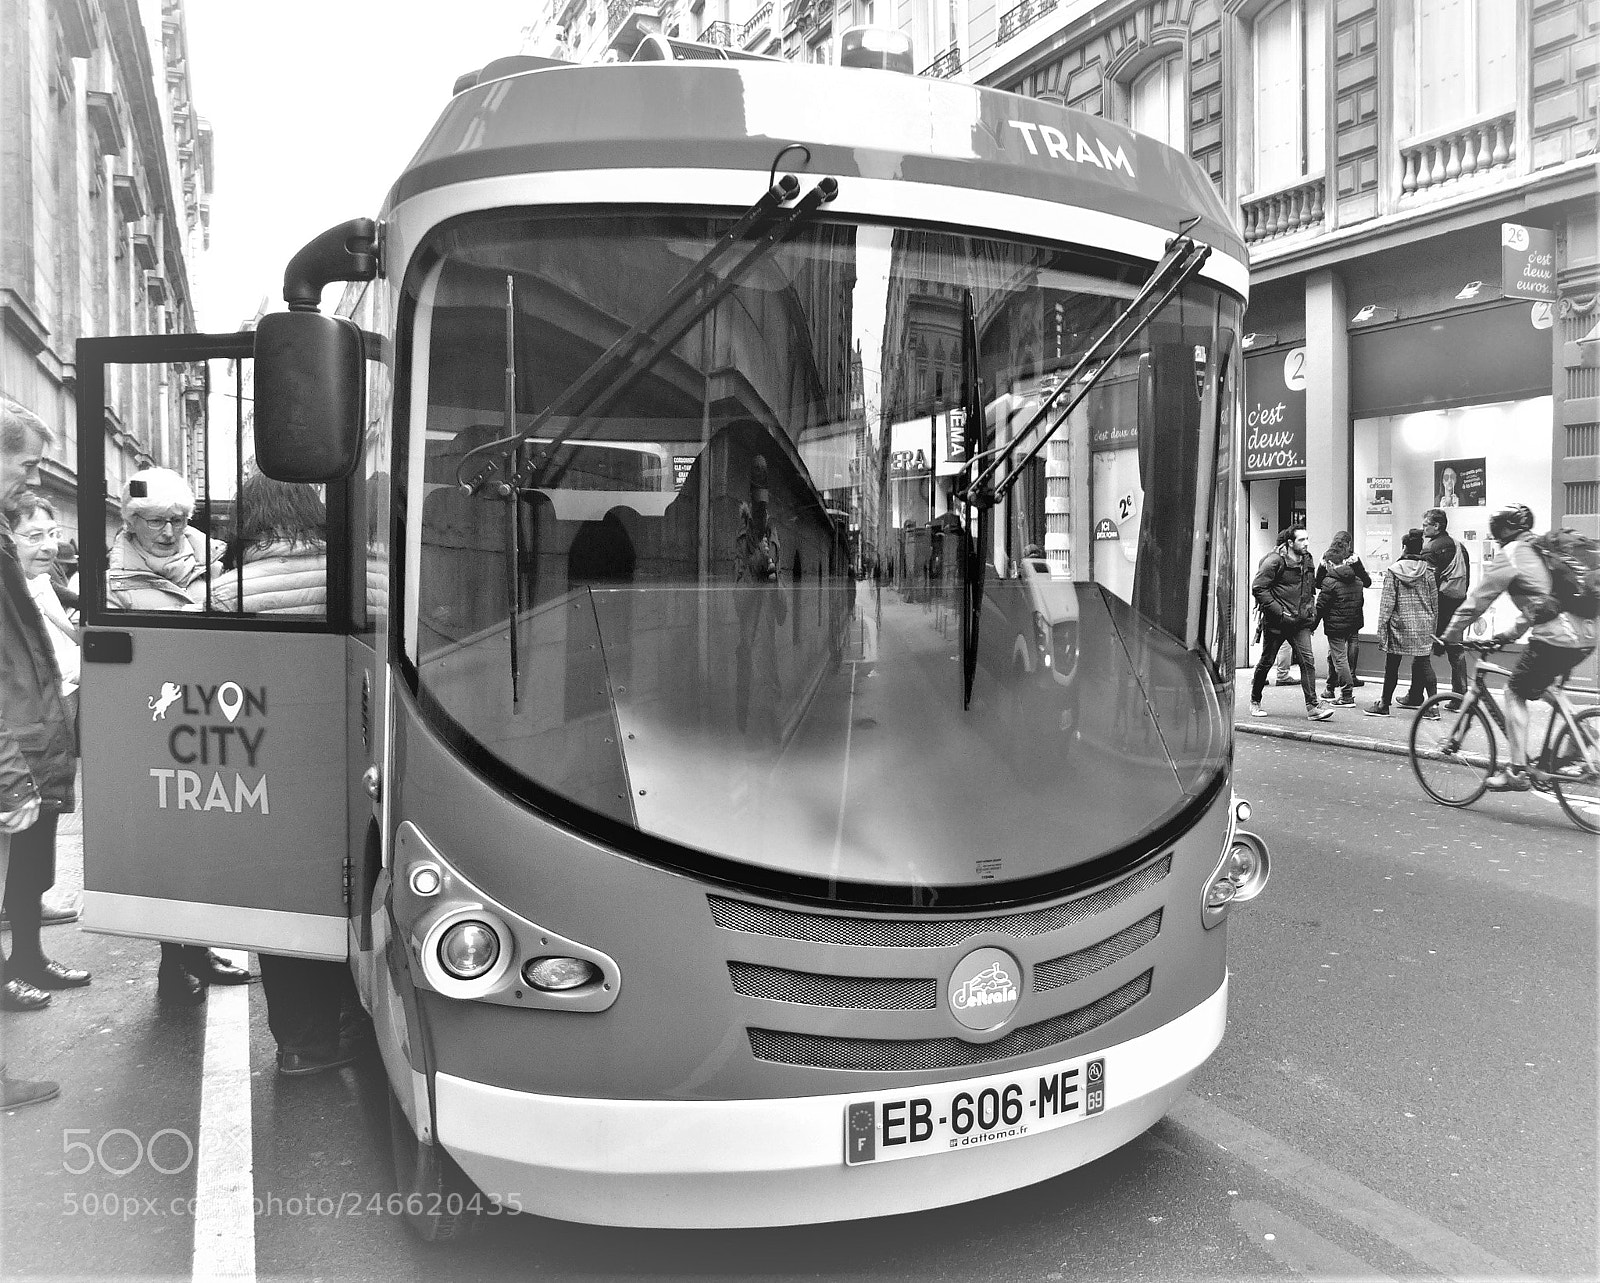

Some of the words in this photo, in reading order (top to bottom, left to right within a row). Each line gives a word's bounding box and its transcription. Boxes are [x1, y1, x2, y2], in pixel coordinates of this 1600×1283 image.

[1008, 120, 1135, 178] TRAM
[1508, 227, 1524, 244] 2€
[1528, 250, 1552, 266] c'est
[1523, 263, 1552, 279] deux
[1247, 402, 1287, 427] c'est
[1247, 427, 1294, 450] deux
[1119, 495, 1132, 519] 2€
[182, 681, 267, 722] LYON
[168, 724, 265, 767] CITY
[150, 768, 270, 815] TRAM
[1087, 1090, 1103, 1110] 69
[857, 1137, 867, 1151] F
[961, 1126, 1028, 1145] dattoma.fr
